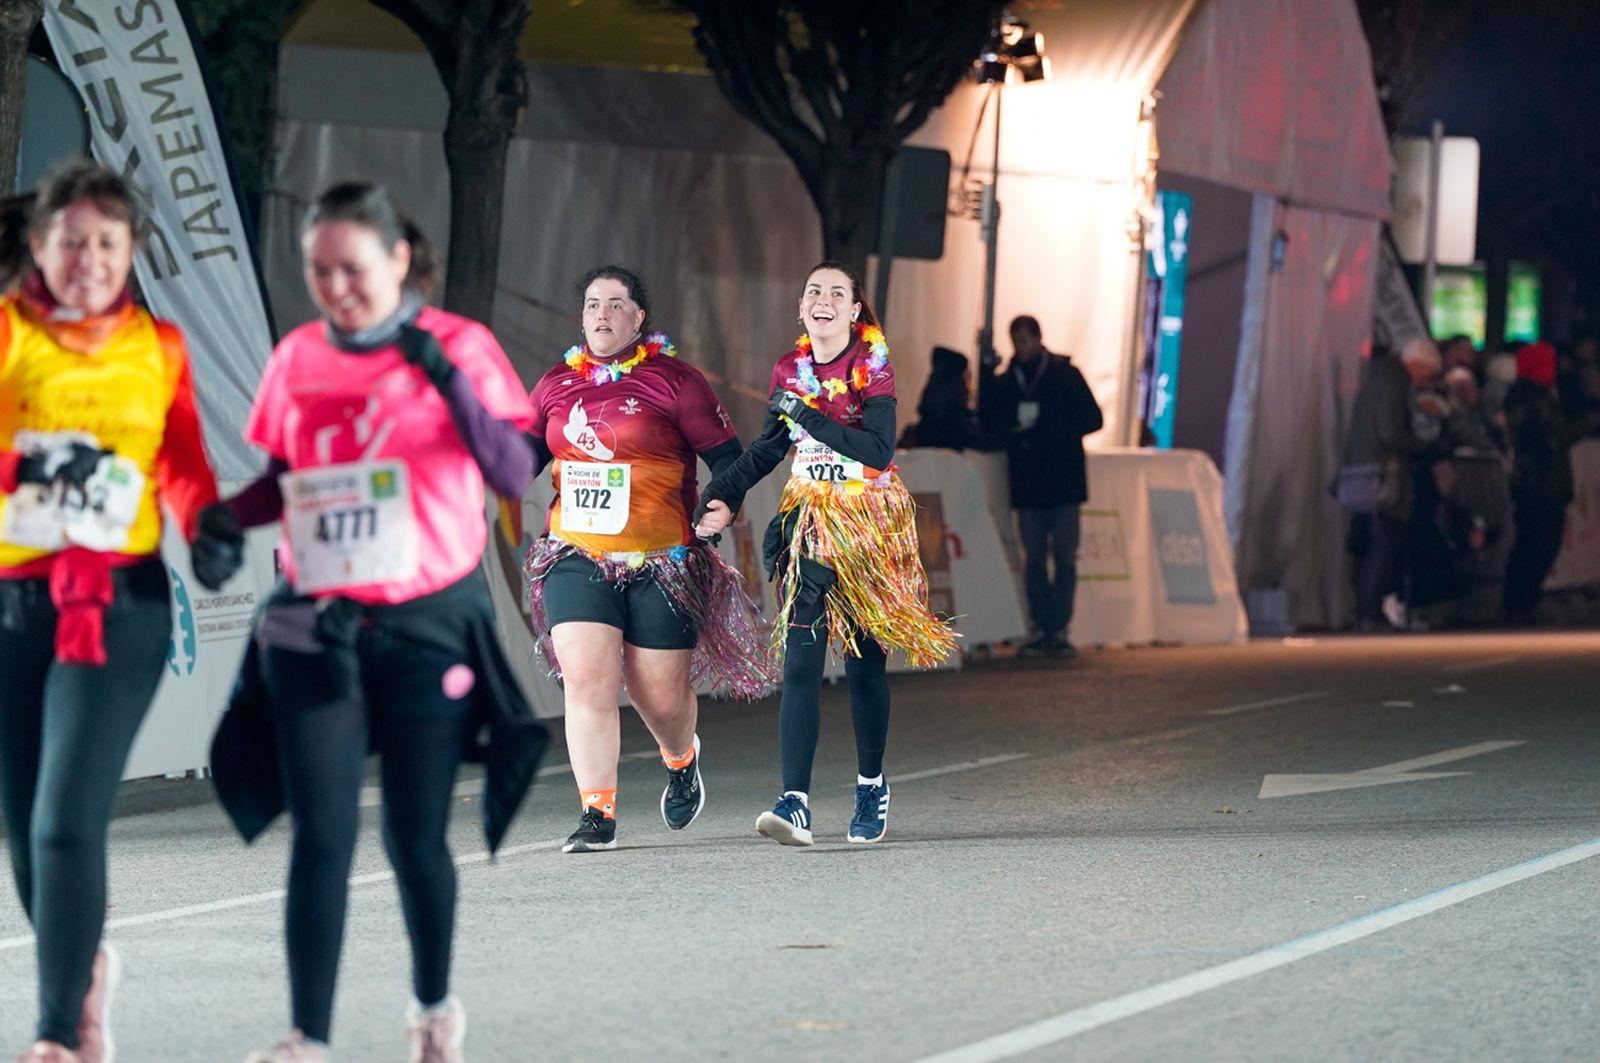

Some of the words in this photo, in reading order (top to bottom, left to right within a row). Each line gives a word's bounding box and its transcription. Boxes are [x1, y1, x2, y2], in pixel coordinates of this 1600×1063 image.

[576, 432, 596, 450] 43
[573, 470, 591, 478] NOCHE
[567, 477, 578, 486] SAN
[573, 487, 612, 509] 1272
